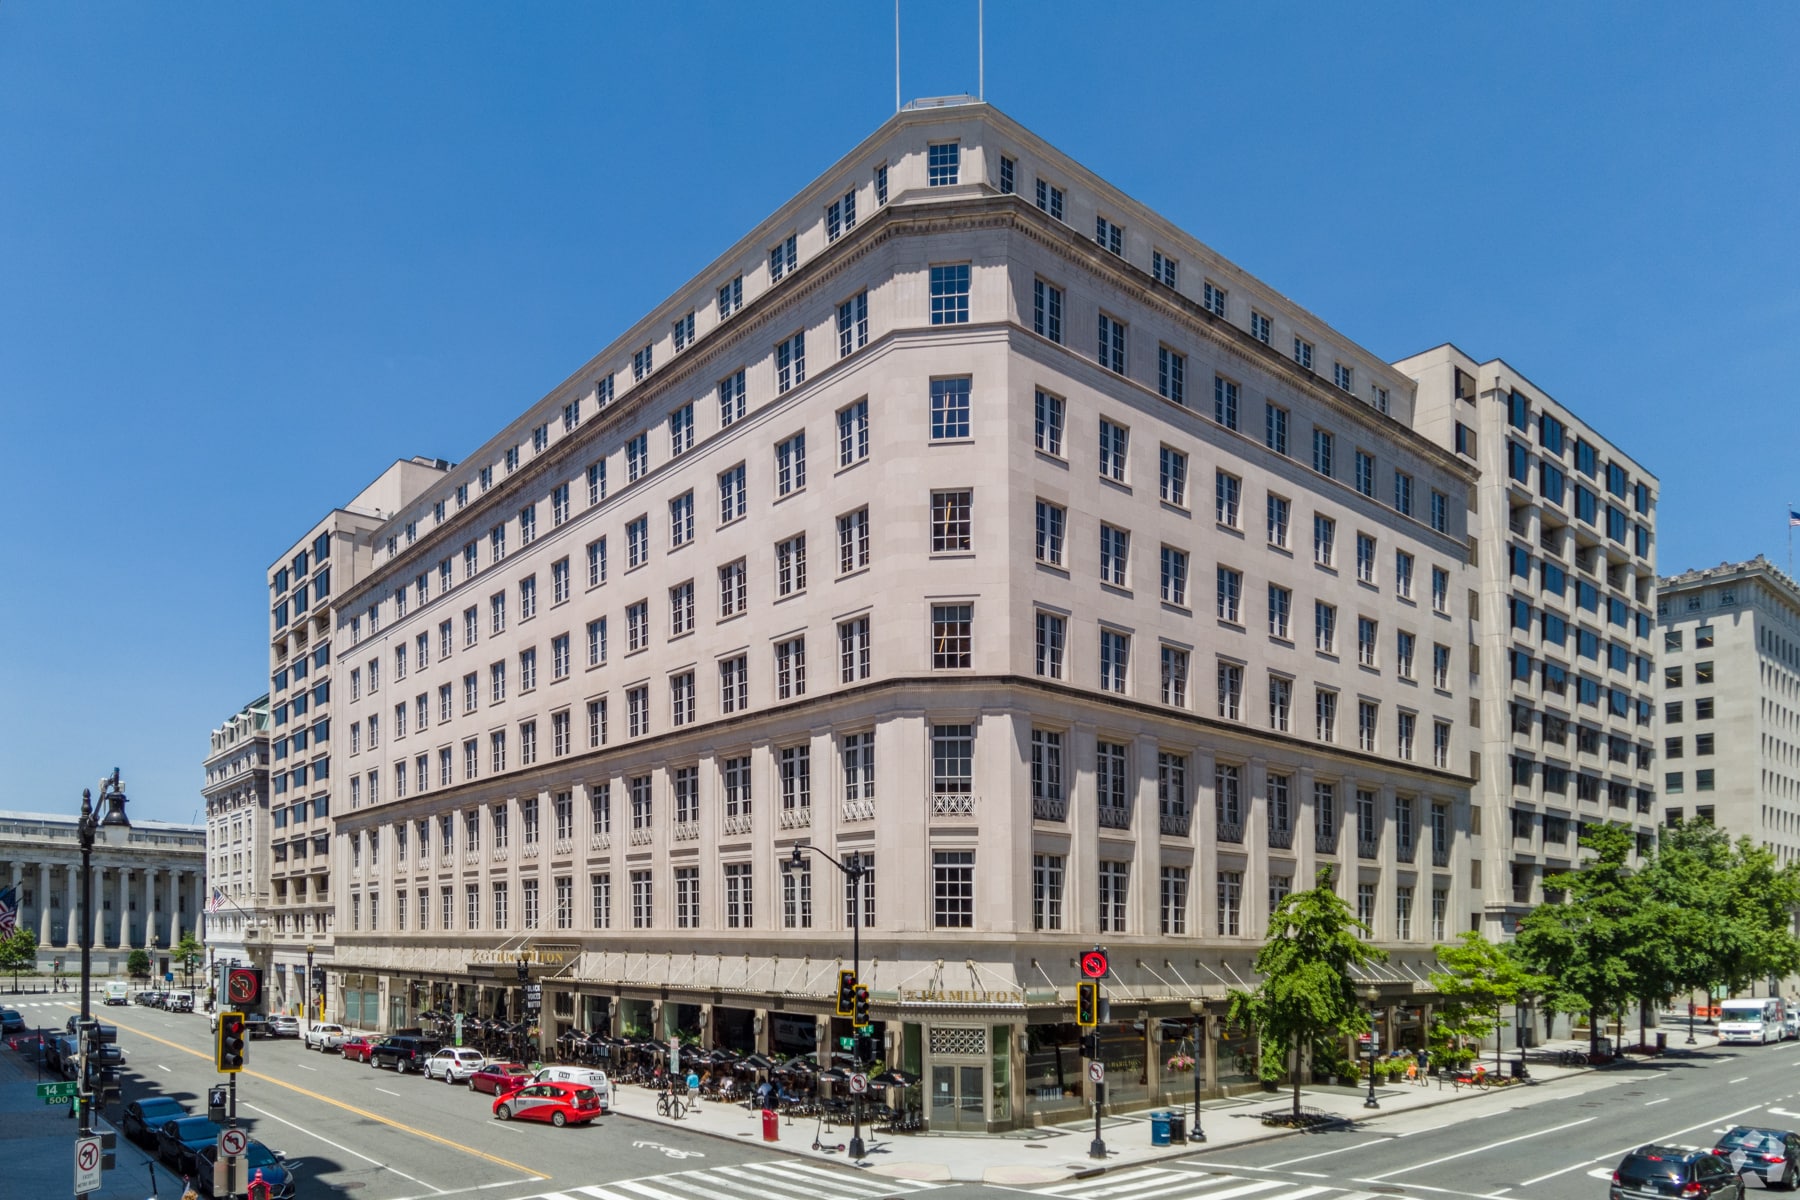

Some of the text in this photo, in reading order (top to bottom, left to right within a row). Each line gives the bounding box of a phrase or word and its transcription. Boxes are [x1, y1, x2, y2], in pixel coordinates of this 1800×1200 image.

[922, 990, 1022, 1003] HAMILTON
[44, 1085, 58, 1096] 14
[49, 1096, 68, 1104] 500
